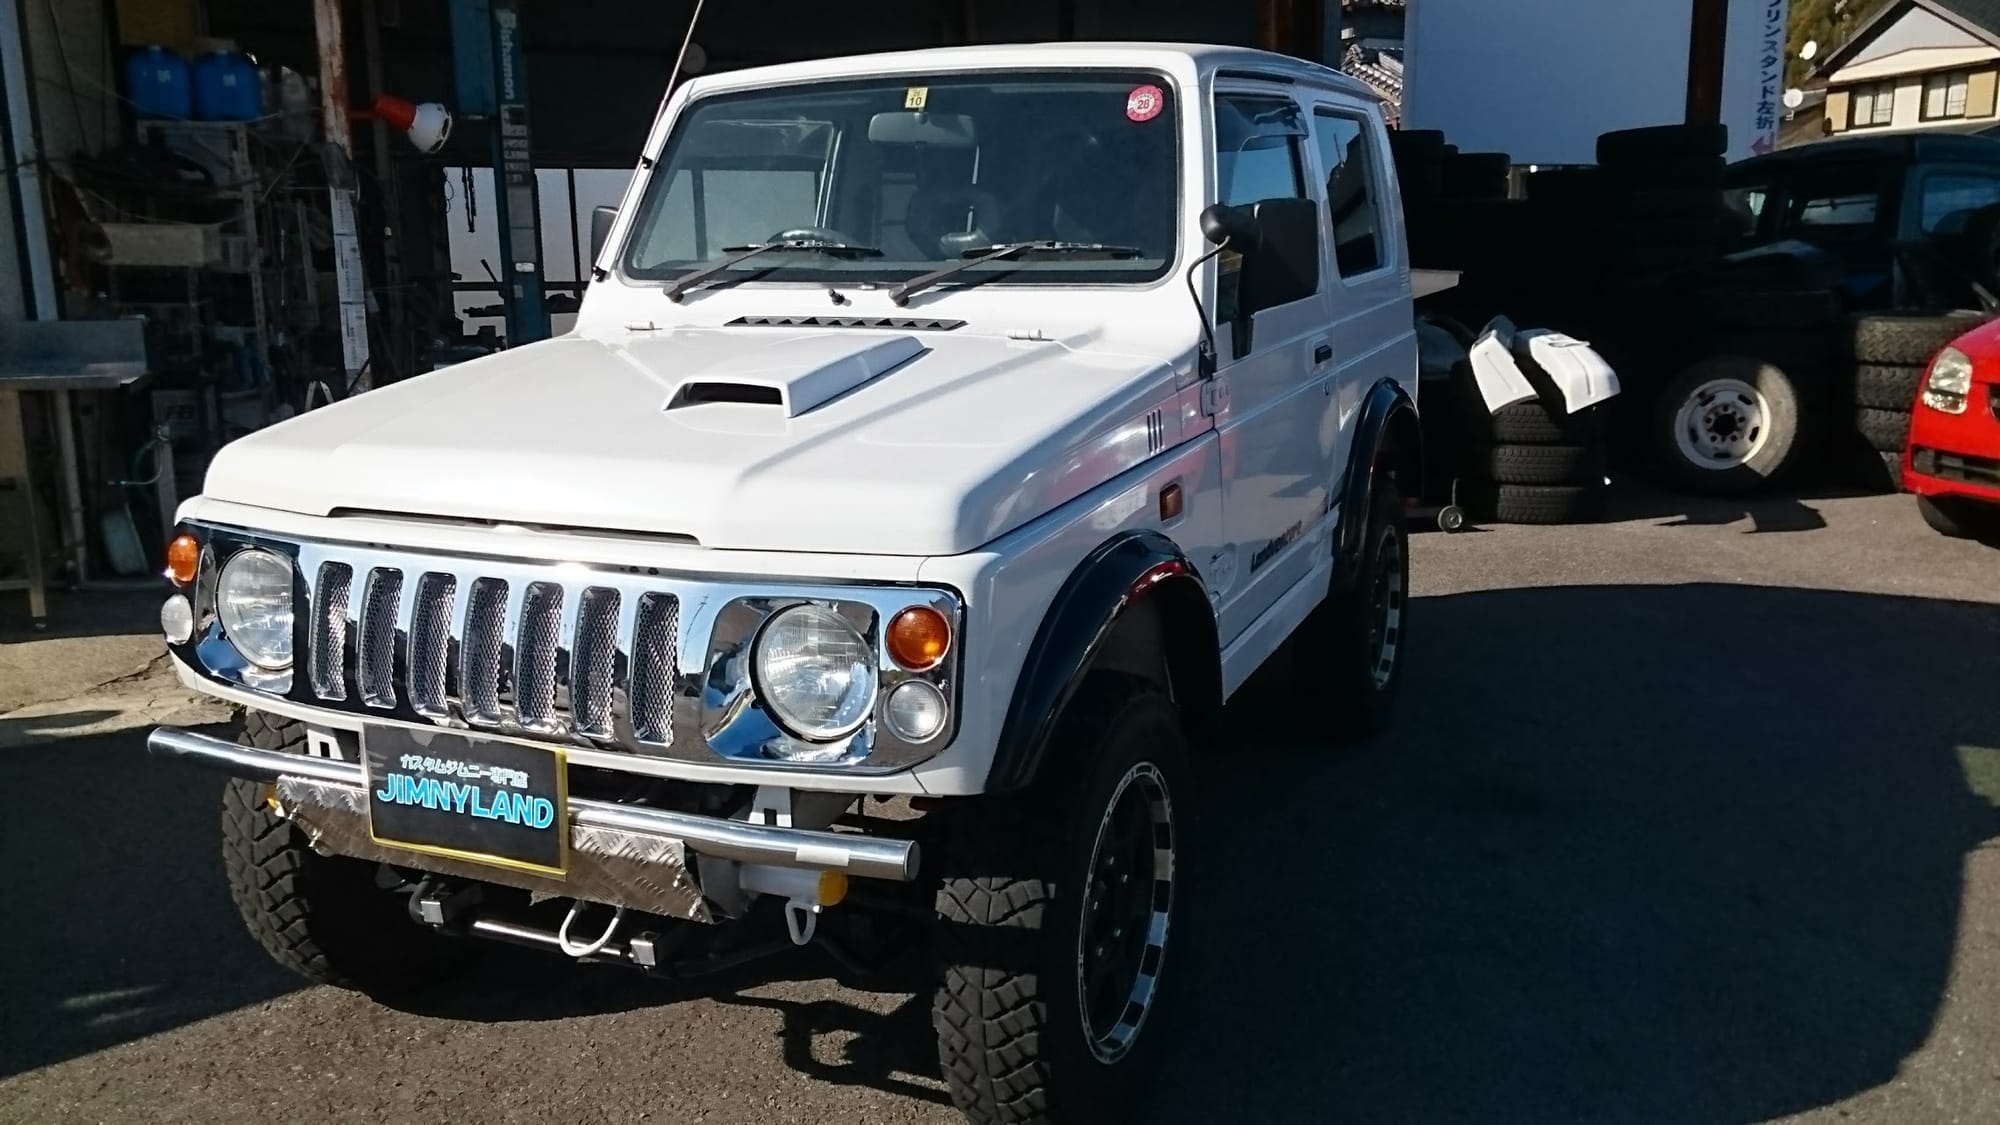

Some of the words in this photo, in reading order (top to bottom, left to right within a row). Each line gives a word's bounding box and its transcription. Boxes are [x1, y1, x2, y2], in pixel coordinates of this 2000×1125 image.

[910, 97, 922, 106] 10
[1137, 99, 1150, 109] 28
[377, 773, 554, 829] JIMNYLAND
